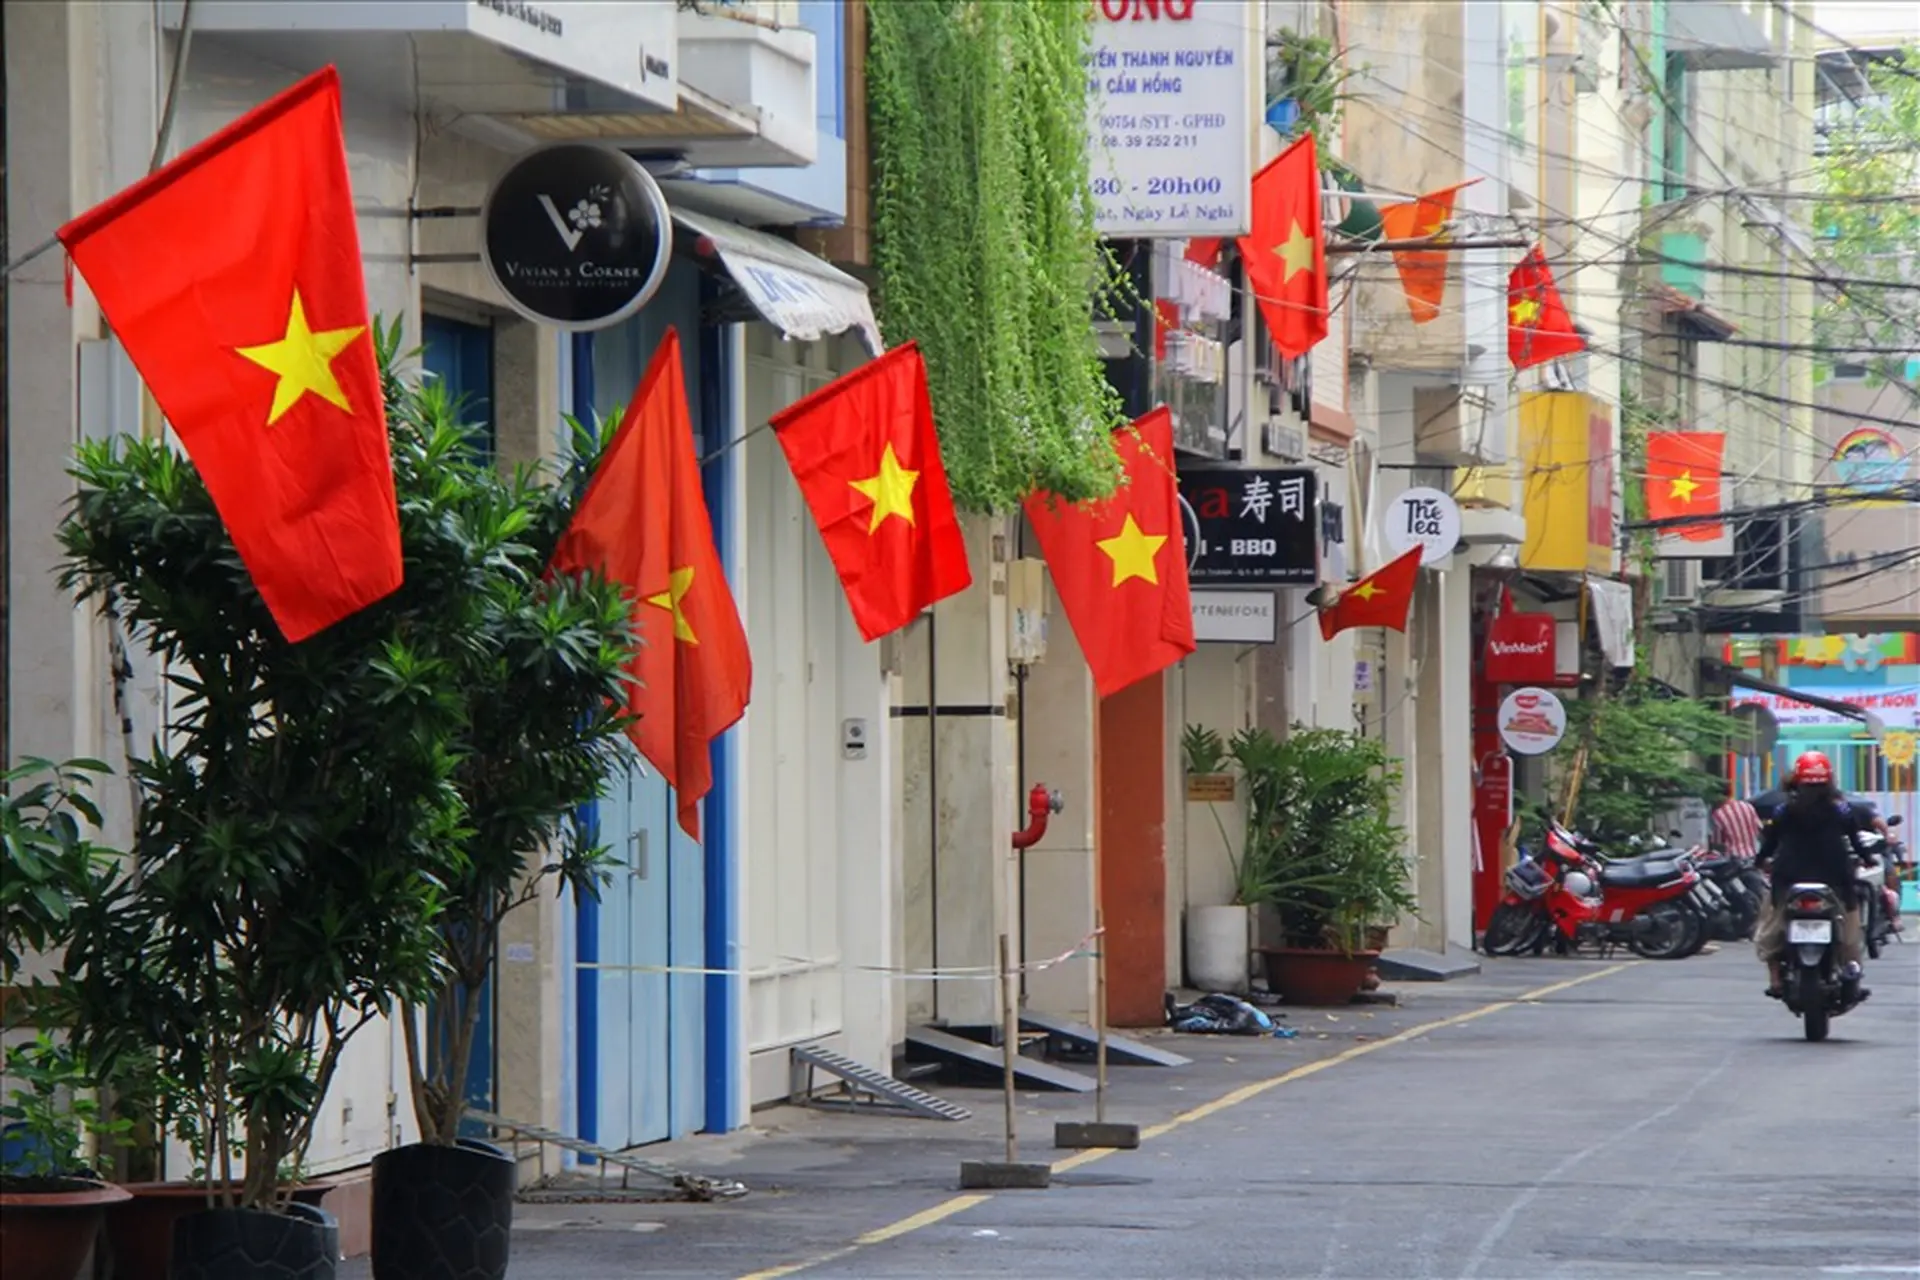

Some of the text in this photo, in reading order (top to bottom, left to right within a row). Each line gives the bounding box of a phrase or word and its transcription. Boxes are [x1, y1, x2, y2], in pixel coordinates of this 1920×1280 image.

[1122, 51, 1170, 67] THANH
[1147, 177, 1221, 195] 20h00
[1239, 475, 1305, 524] 寿司
[1230, 539, 1278, 557] BBQ
